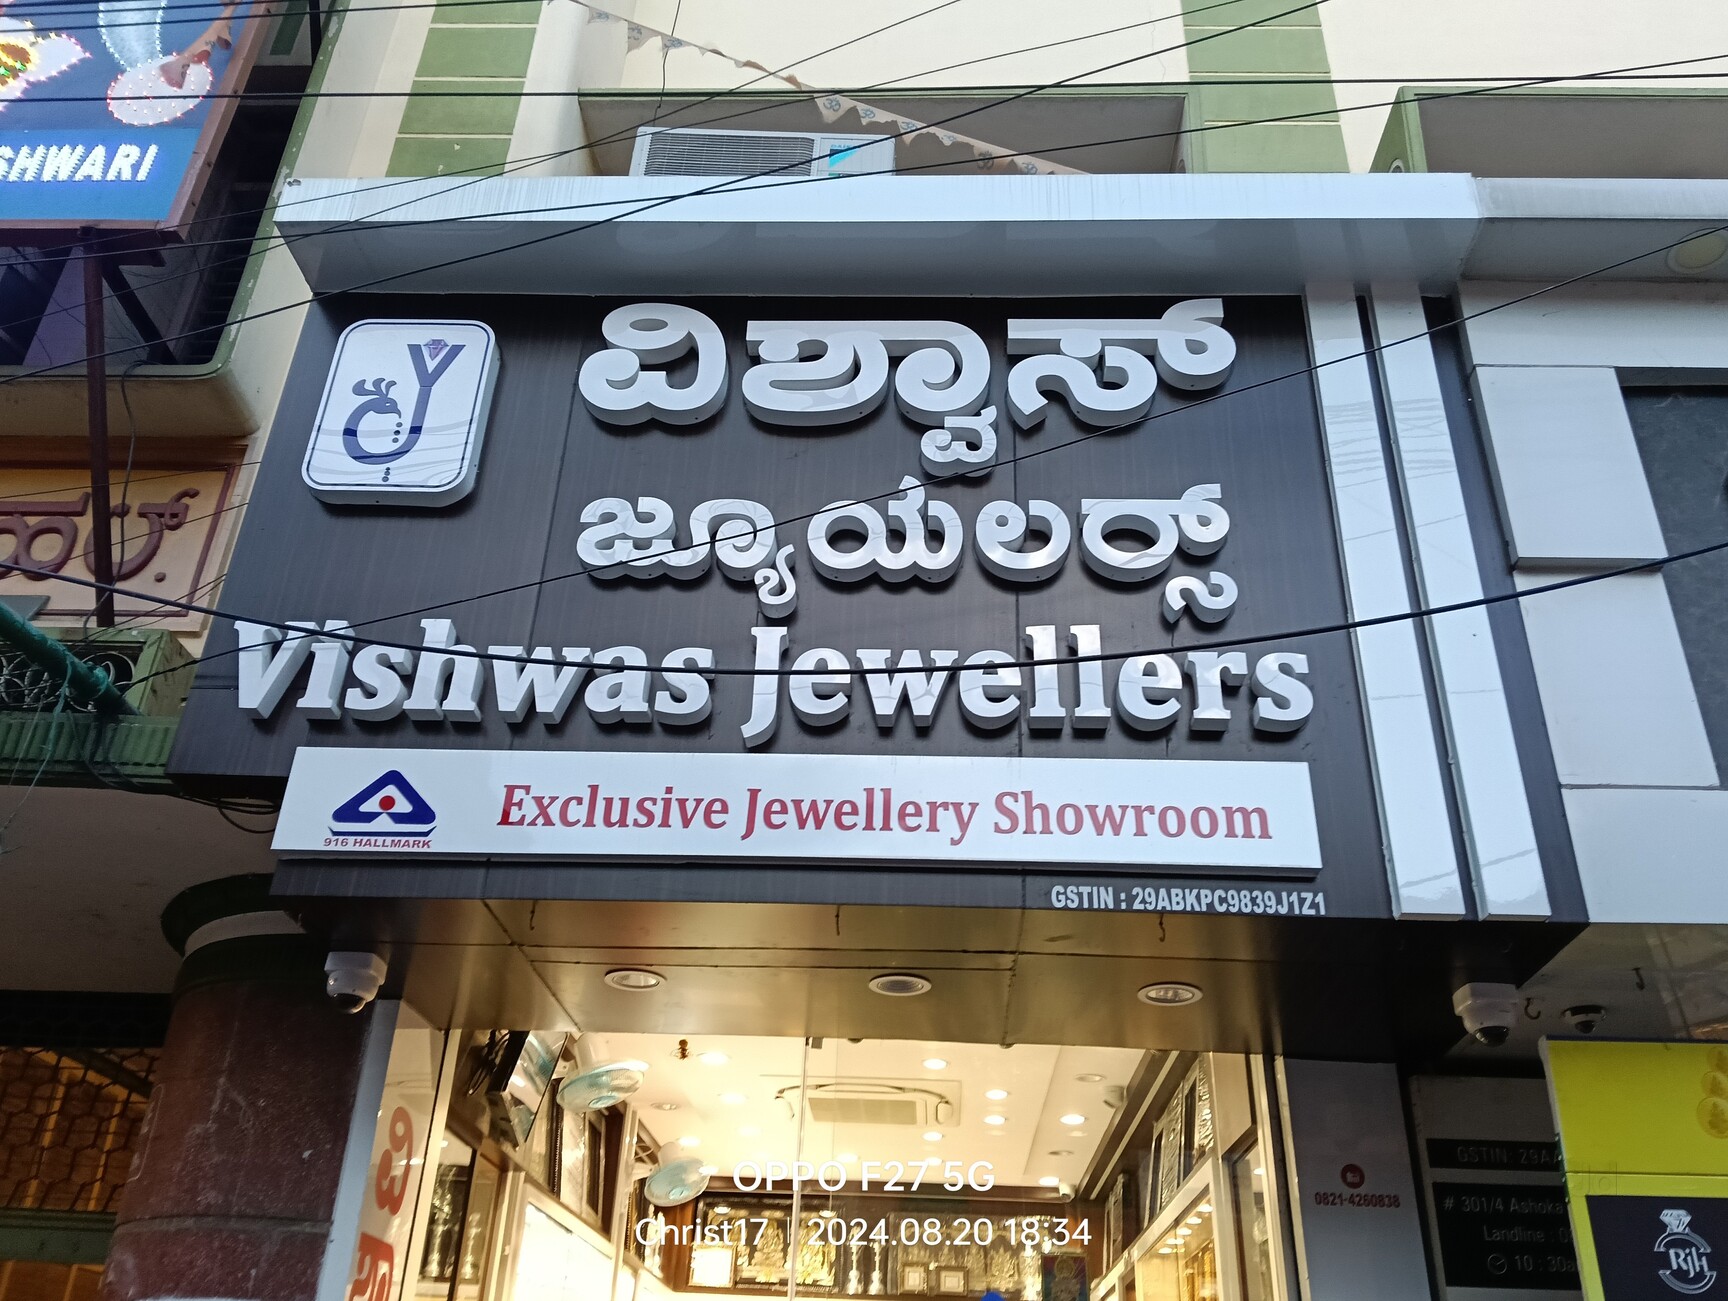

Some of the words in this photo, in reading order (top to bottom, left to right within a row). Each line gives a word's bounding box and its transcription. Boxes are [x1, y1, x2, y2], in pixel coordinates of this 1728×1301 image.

[578, 297, 1237, 477] ವಿಶ್ವಾಸ್
[233, 618, 715, 725] Vishwas
[740, 624, 1313, 748] Jewellers
[323, 837, 349, 847] 916
[353, 838, 433, 849] HALLMARK
[497, 784, 730, 830] Exclusive
[741, 787, 979, 846] Jewellery
[994, 790, 1273, 841] Showroom
[1051, 885, 1114, 910] GSTIN
[1132, 886, 1326, 916] 29ABKPC9839J1Z1
